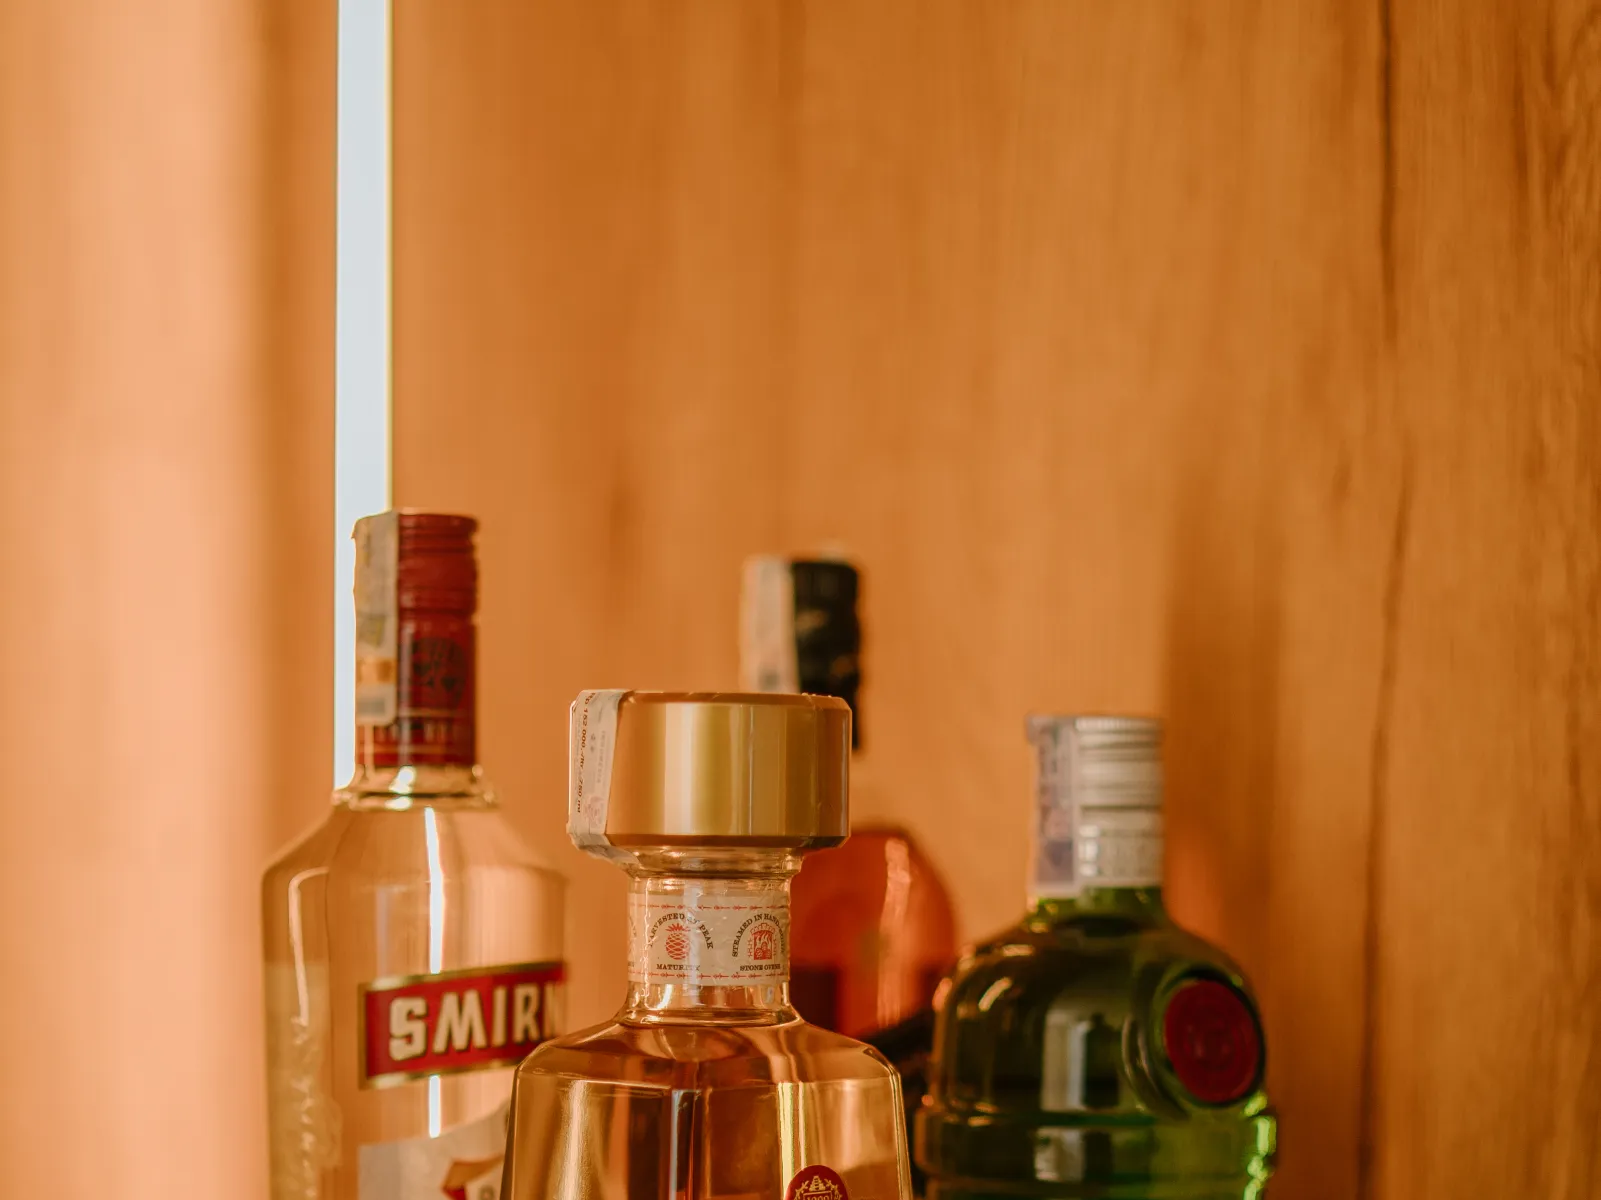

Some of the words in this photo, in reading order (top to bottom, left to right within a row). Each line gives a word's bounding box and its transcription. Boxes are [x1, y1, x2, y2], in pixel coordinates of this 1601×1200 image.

[699, 924, 714, 950] PEAK
[731, 918, 753, 957] STEAMED
[753, 913, 763, 921] IN
